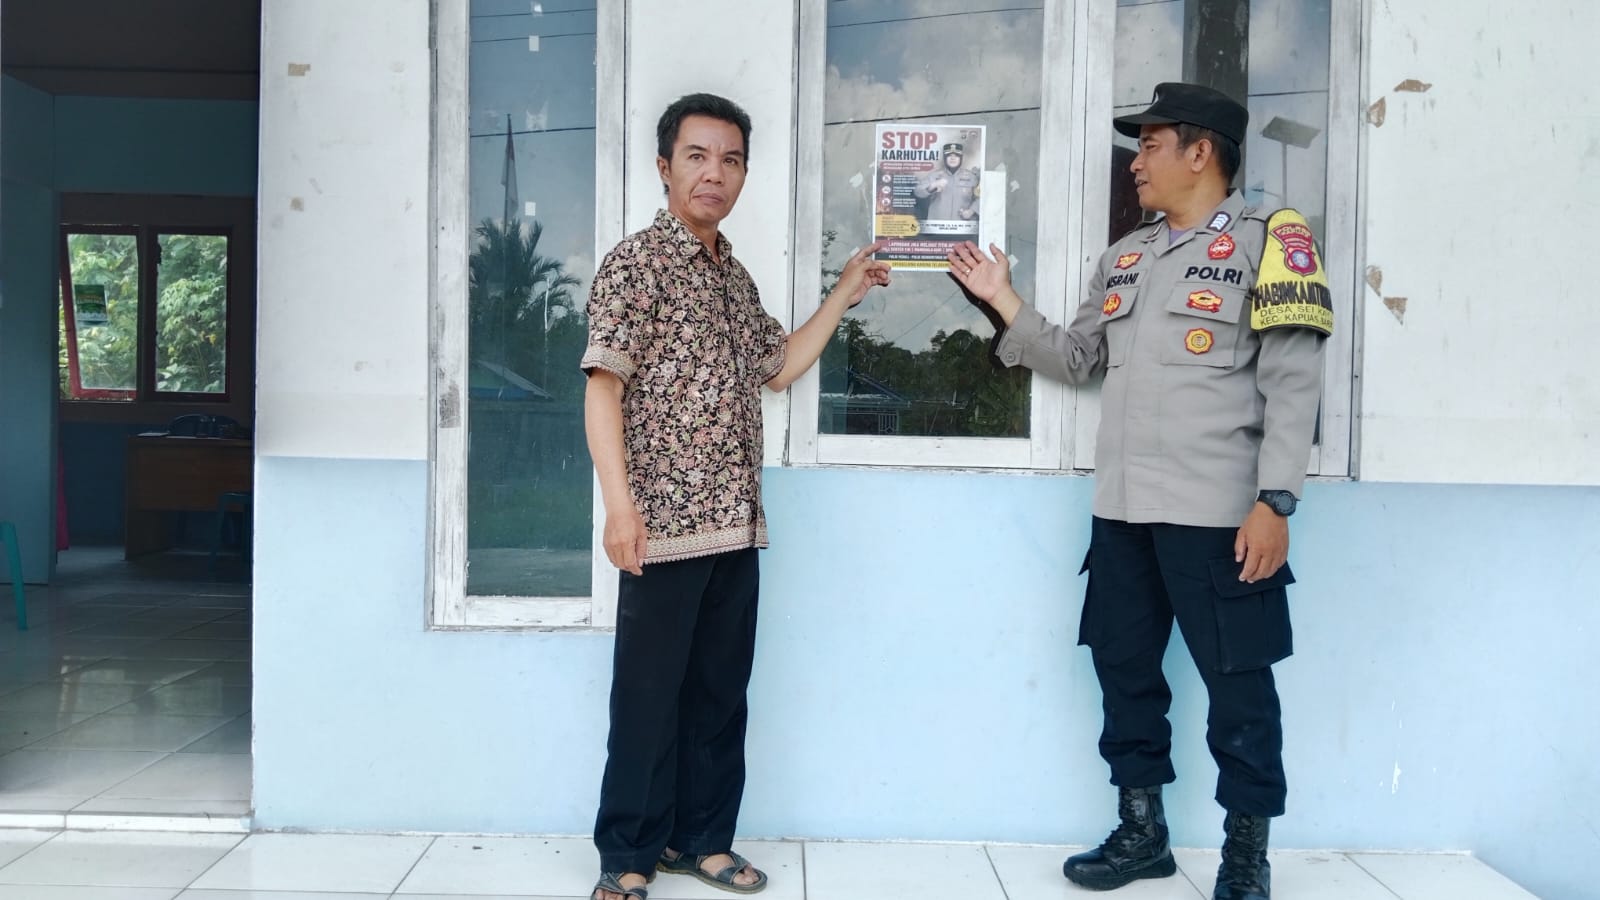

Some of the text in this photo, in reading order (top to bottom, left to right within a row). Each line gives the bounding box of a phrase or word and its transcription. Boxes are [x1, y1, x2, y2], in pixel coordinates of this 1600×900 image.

[882, 131, 938, 150] STOP
[881, 150, 939, 161] KARHUTLA!
[1185, 266, 1243, 285] POLRI
[1260, 305, 1293, 318] DESA
[1297, 305, 1315, 313] SEI
[1284, 313, 1318, 324] KAPUAS
